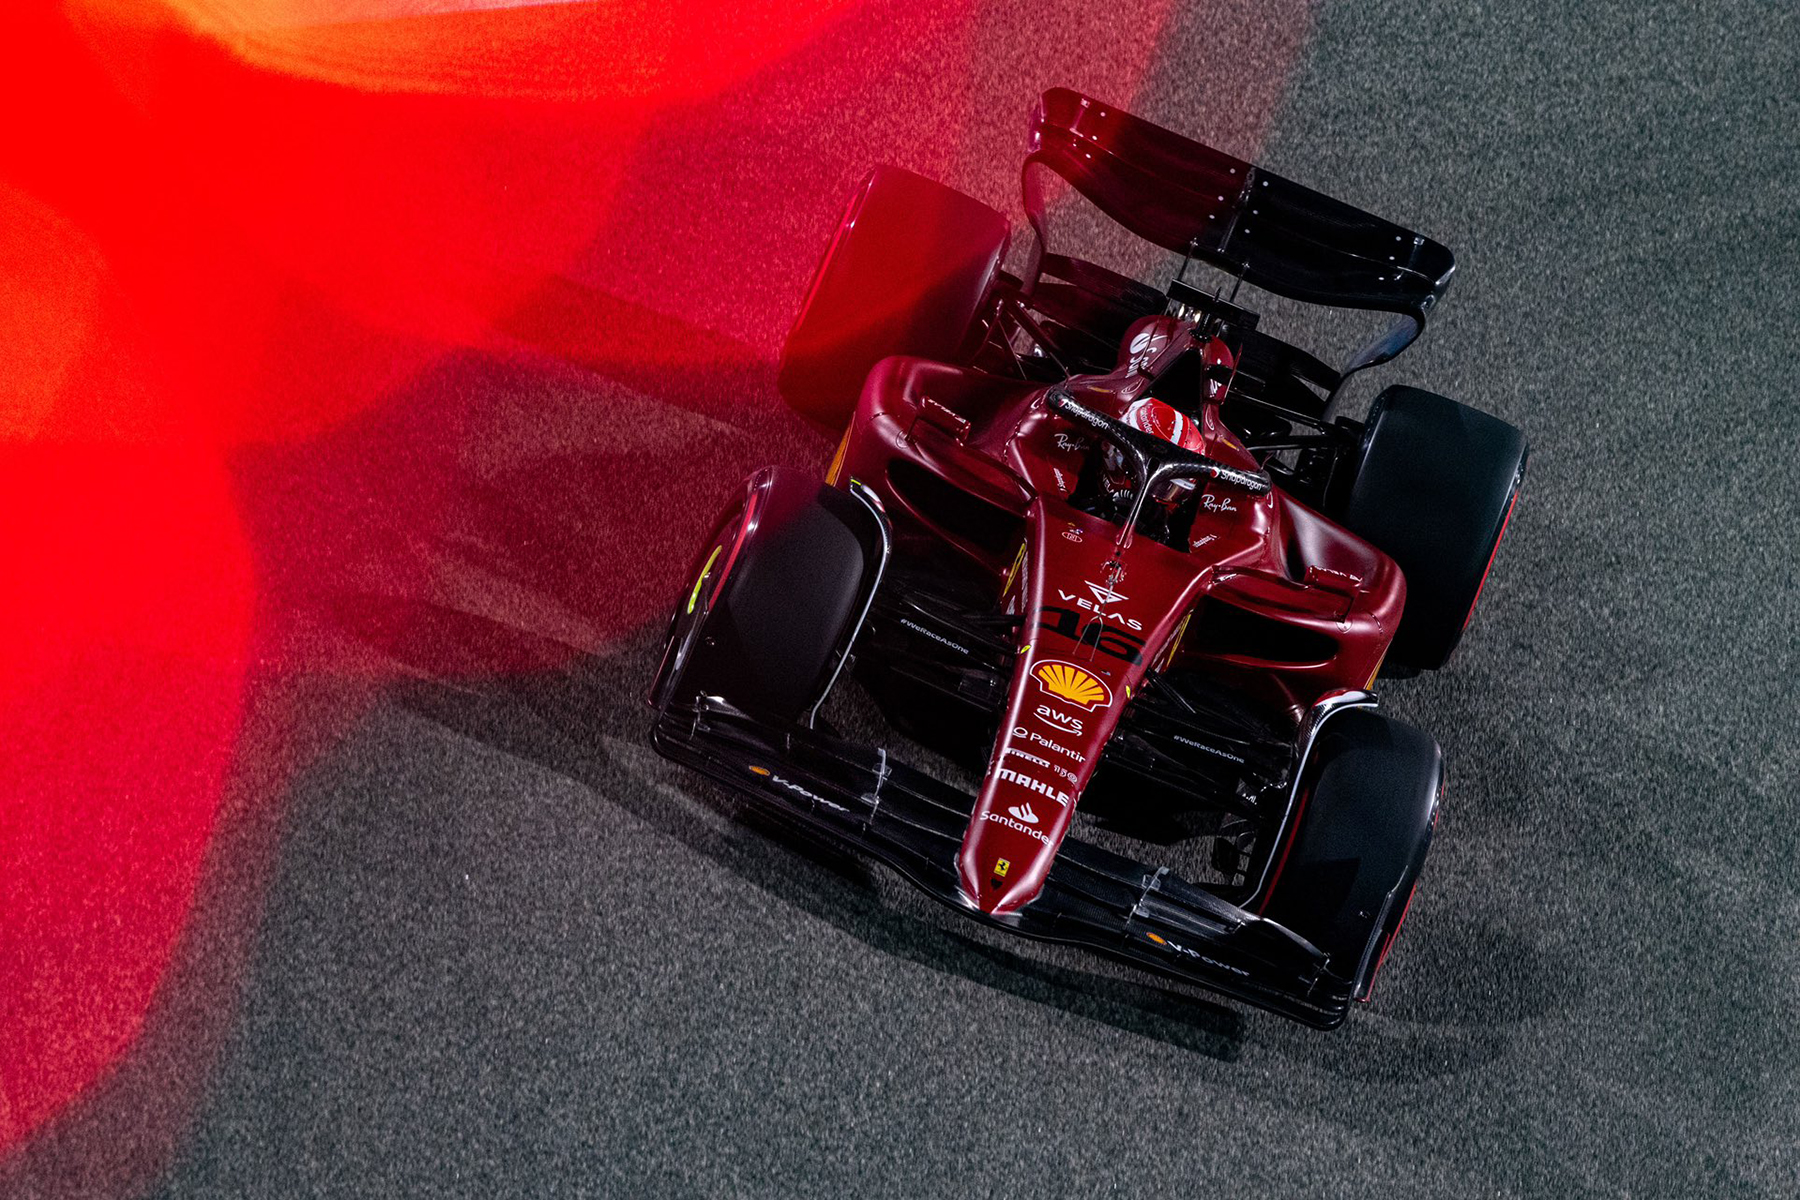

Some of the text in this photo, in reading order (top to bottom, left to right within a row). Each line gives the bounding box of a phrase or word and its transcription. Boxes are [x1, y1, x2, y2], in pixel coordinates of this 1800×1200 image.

[1065, 400, 1109, 429] Snapdragon
[1054, 433, 1090, 452] Ray-Ban
[1220, 471, 1263, 491] Snapdragon
[1201, 494, 1237, 512] Ray-Ban
[1058, 589, 1143, 631] VELAS
[901, 618, 969, 655] #WeRaceAsOne
[1036, 605, 1147, 666] 16
[1036, 704, 1084, 730] aws
[1030, 732, 1086, 763] Palantir
[1173, 735, 1245, 764] #WeRaceAsOne
[997, 768, 1070, 807] MAHLE
[980, 810, 1054, 847] Santander
[1167, 940, 1250, 977] V-Power
